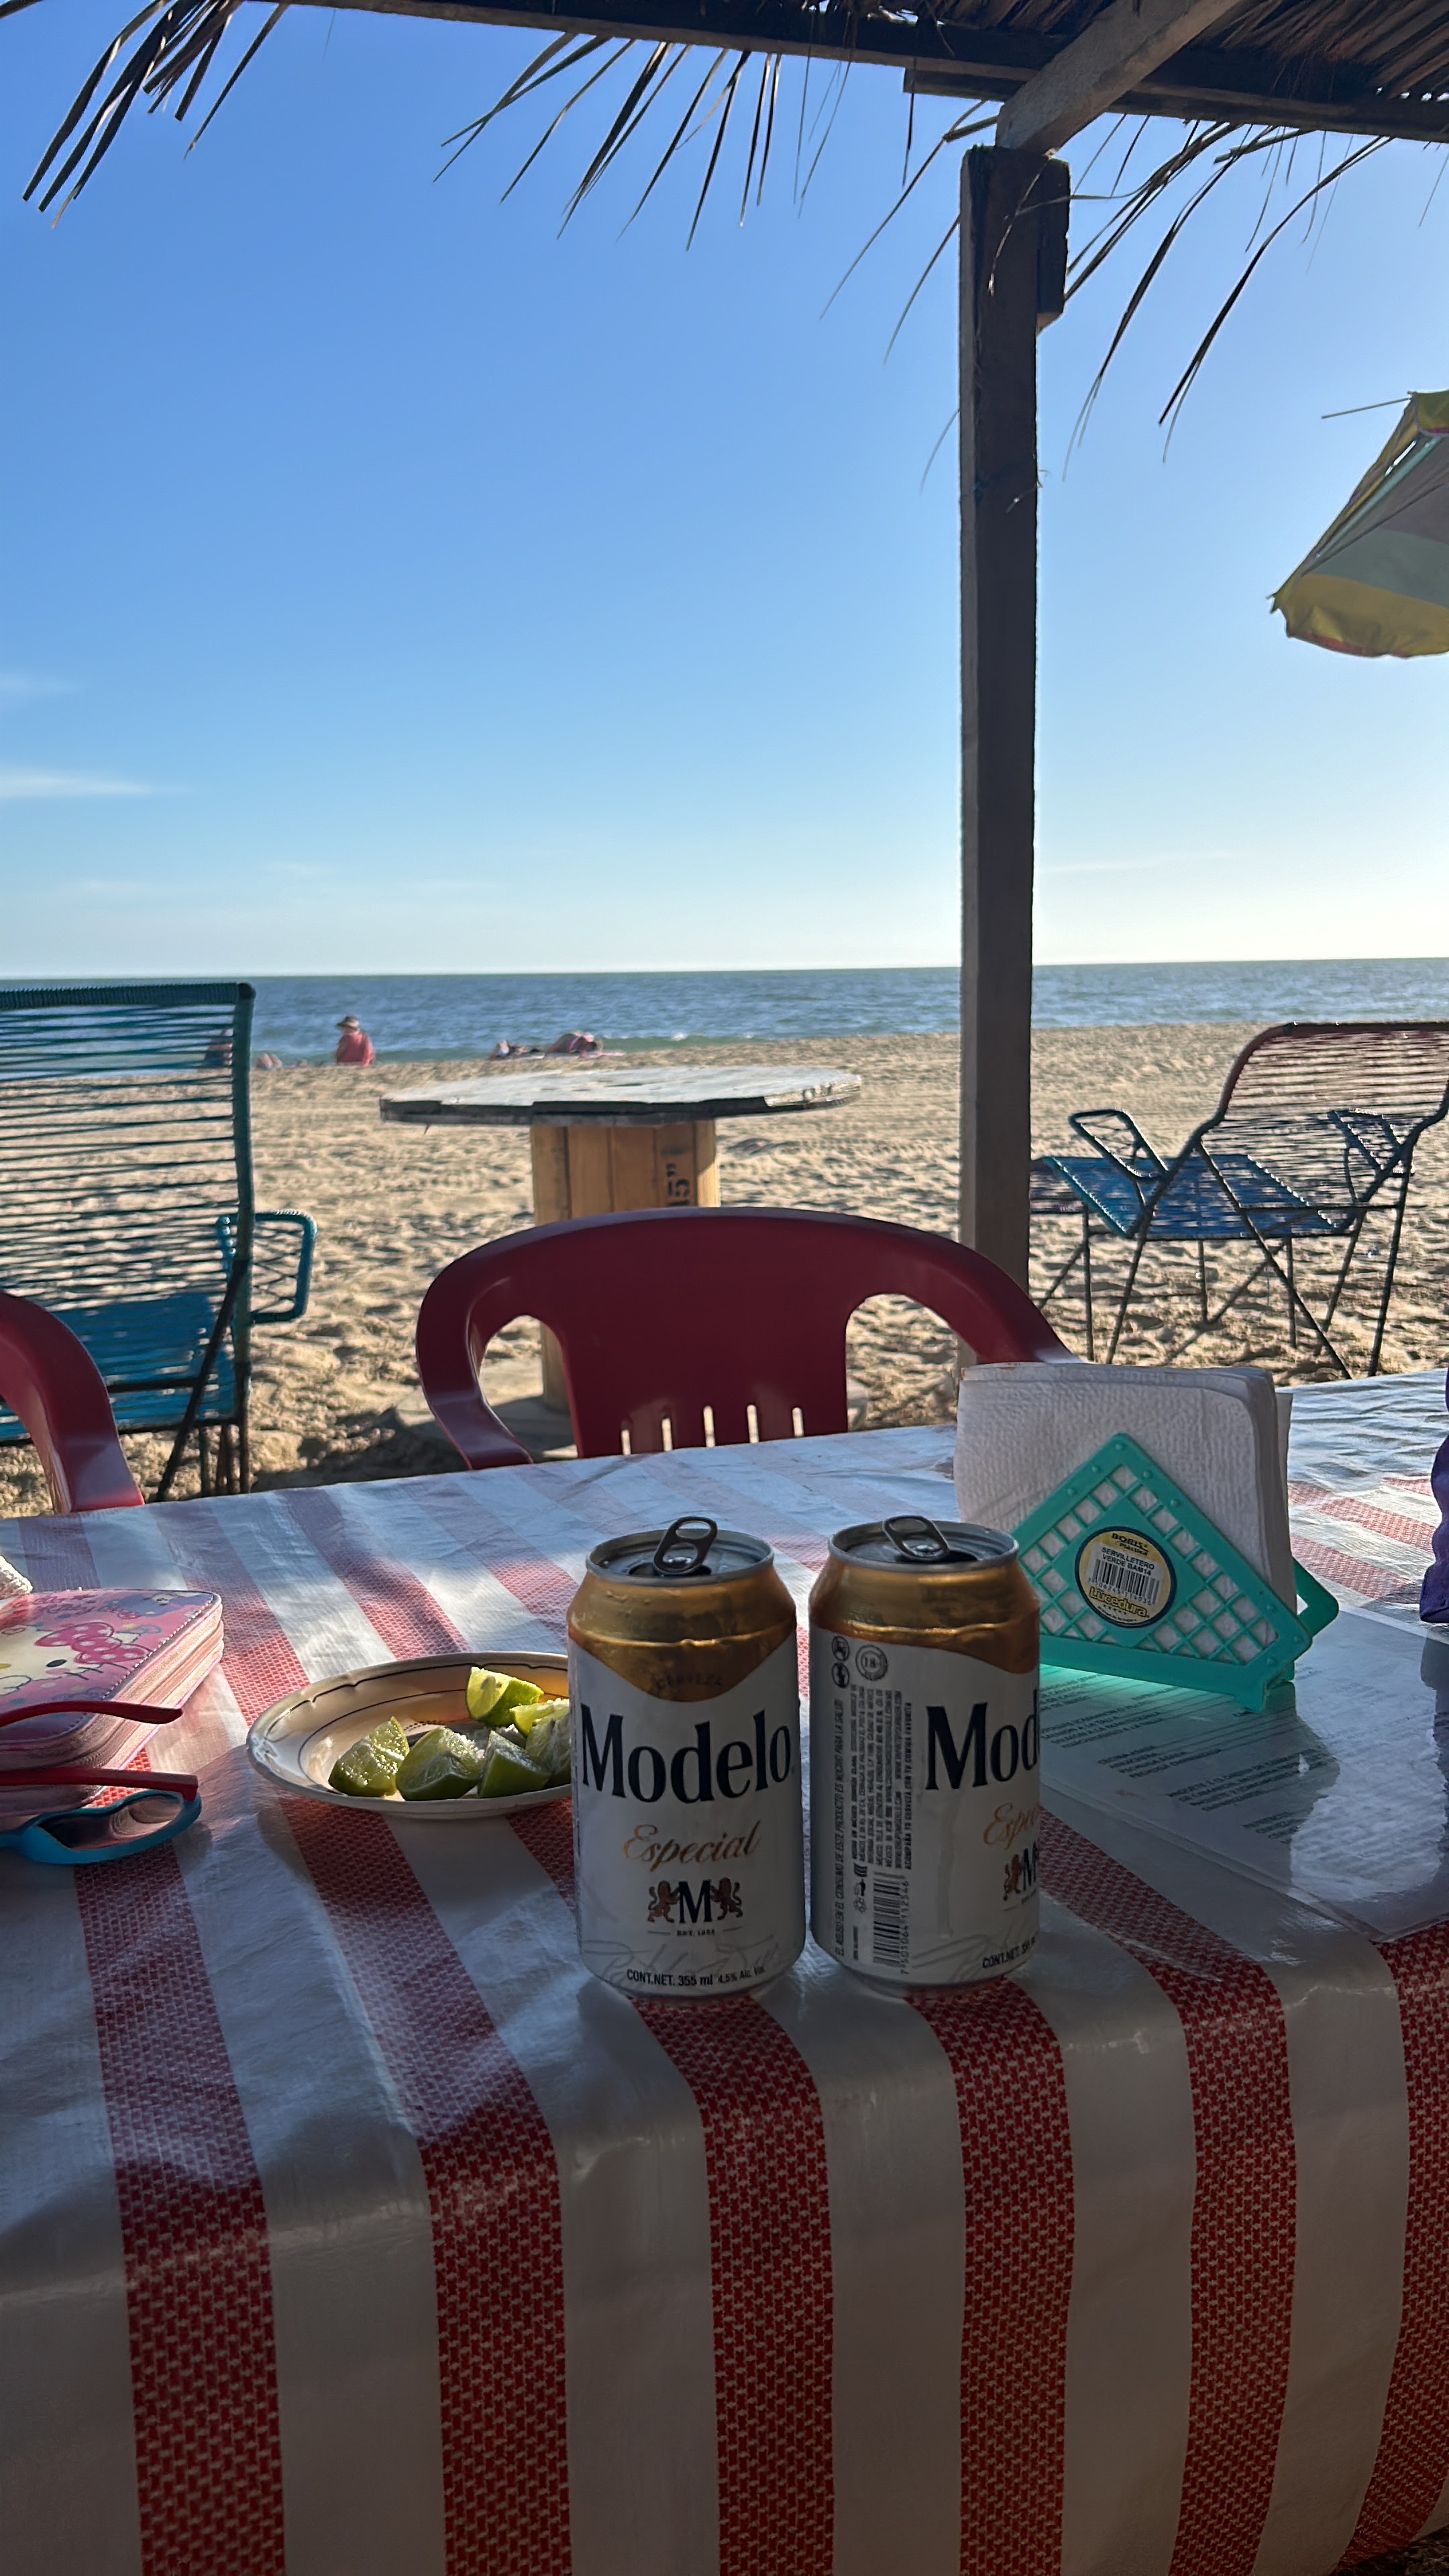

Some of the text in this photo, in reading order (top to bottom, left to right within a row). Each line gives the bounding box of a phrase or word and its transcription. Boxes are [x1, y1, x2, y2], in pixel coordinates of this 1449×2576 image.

[1102, 1547, 1155, 1570] SERVILLETERO
[1103, 1554, 1151, 1576] VERDE BAM14
[581, 1702, 792, 1803] Modelo
[623, 1821, 761, 1872] Especial
[679, 1880, 713, 1924] M
[678, 1974, 698, 1986] 355
[700, 1974, 713, 1986] ml
